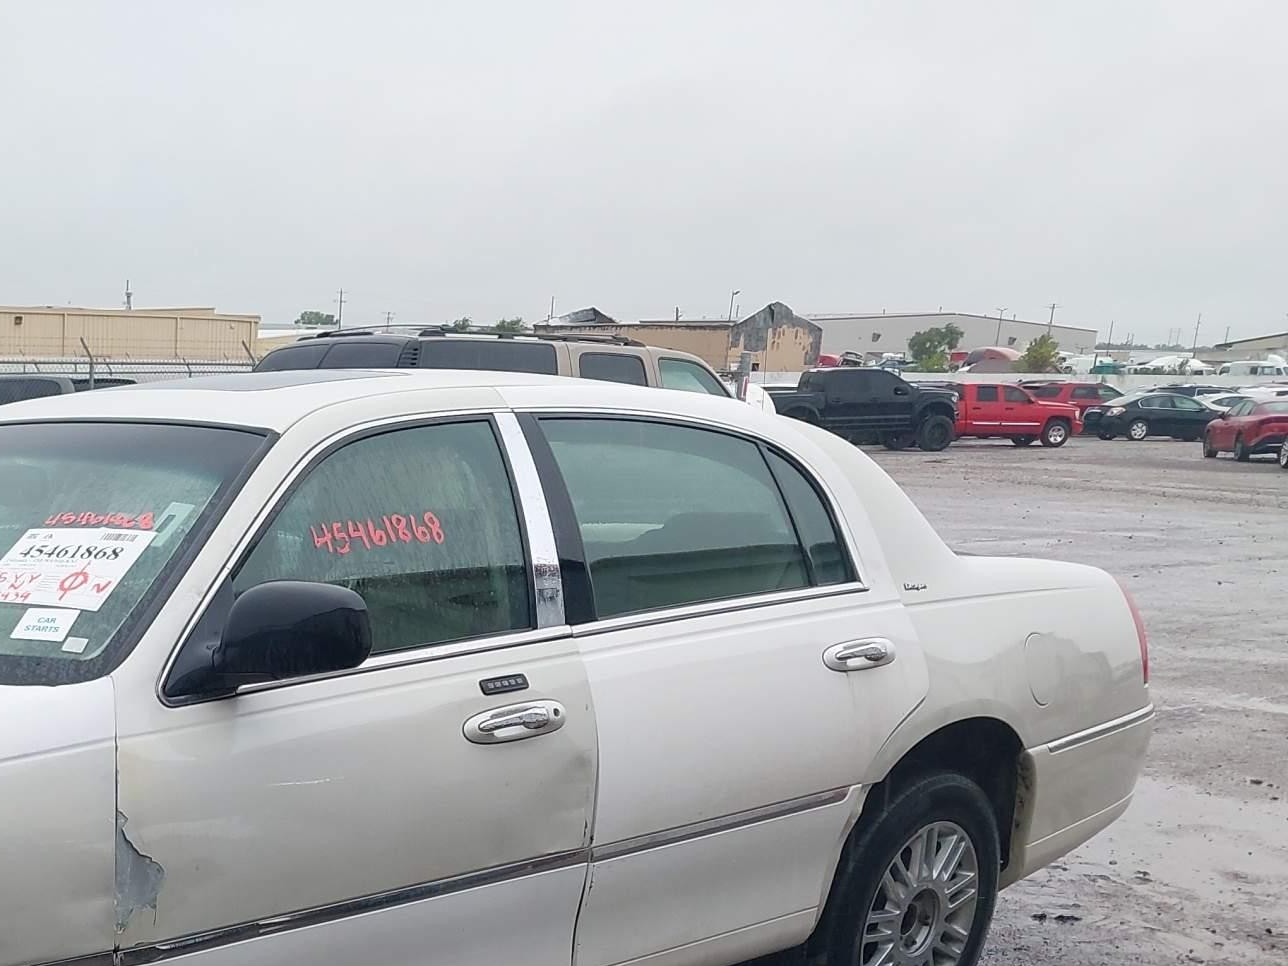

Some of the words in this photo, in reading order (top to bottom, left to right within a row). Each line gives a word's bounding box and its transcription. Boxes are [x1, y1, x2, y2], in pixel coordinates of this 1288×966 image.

[310, 511, 445, 554] 45461868
[18, 544, 125, 561] 45461868
[23, 624, 60, 633] STARTS
